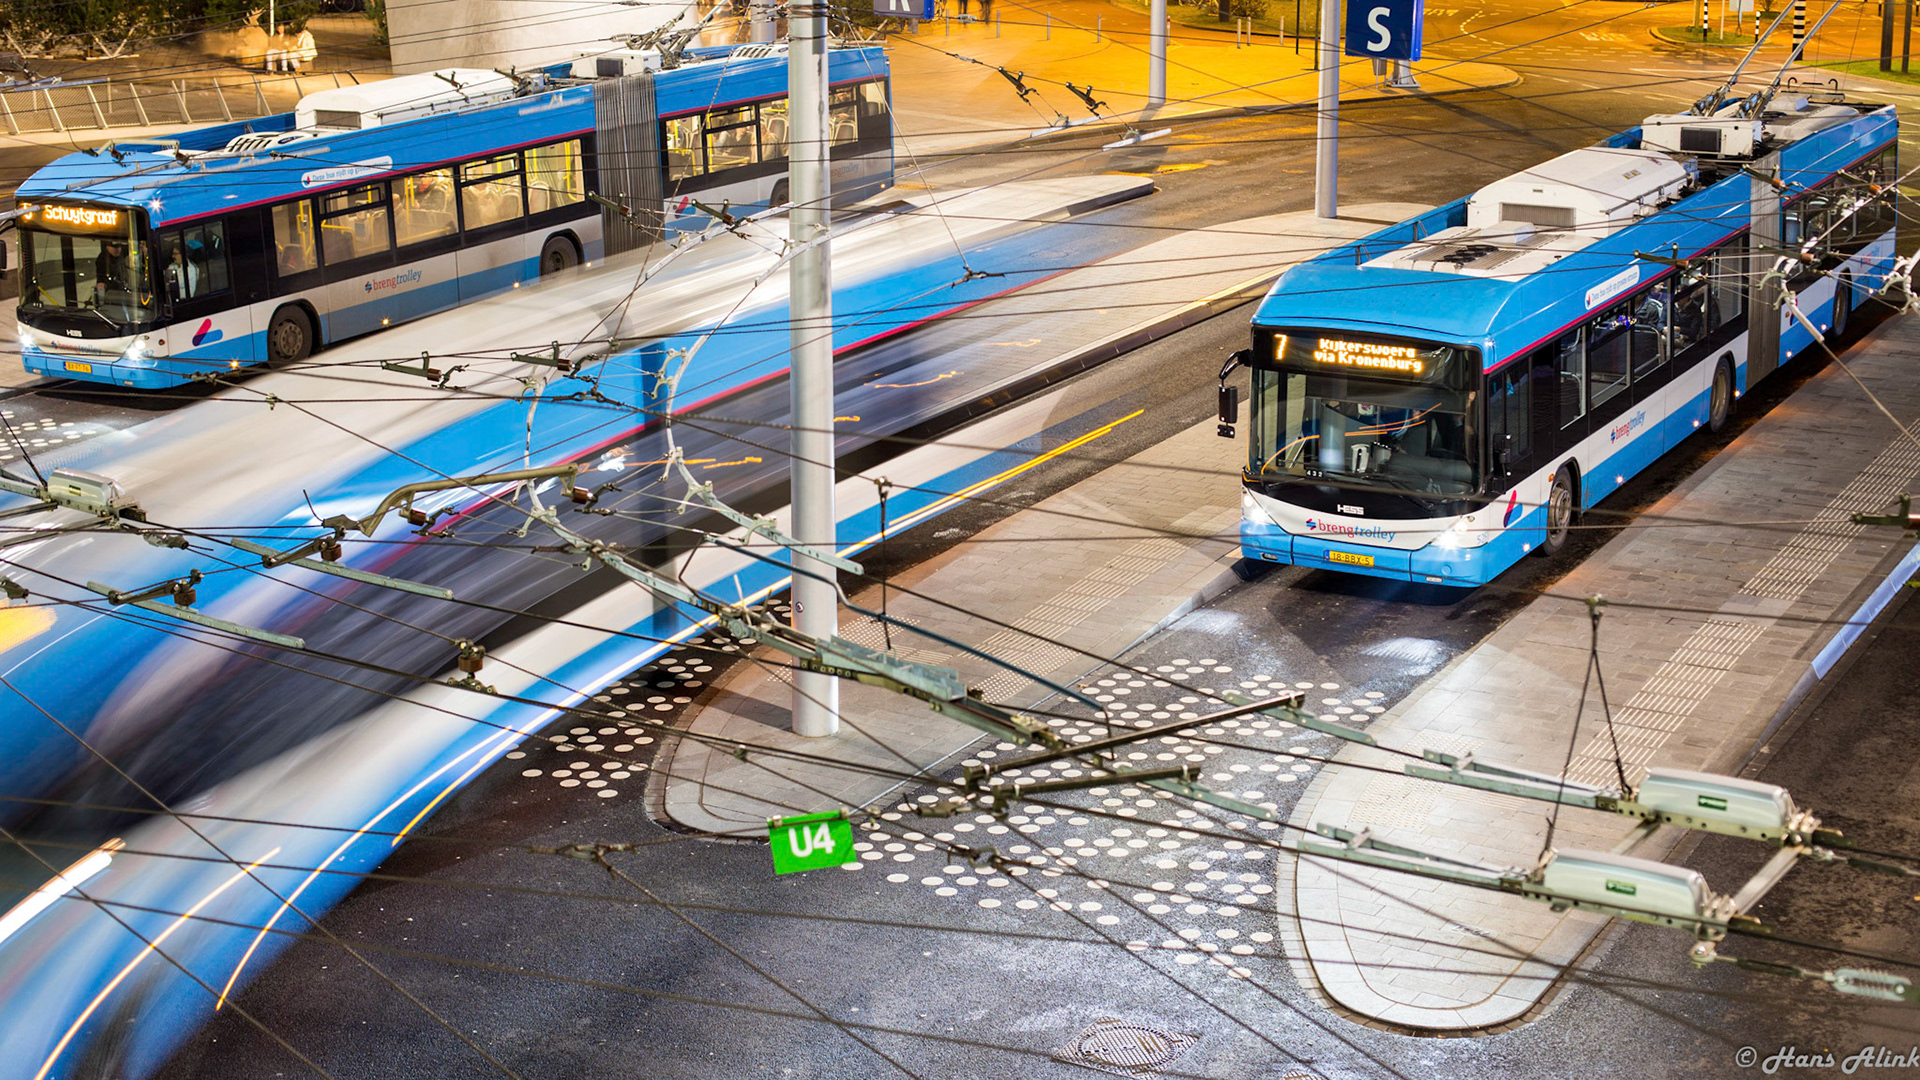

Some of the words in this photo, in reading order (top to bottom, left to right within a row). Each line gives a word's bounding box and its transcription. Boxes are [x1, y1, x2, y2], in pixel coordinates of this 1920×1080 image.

[1366, 6, 1392, 52] S
[44, 204, 118, 226] Schuytgraaf
[372, 269, 422, 290] brengtrolley
[1274, 333, 1288, 361] 7
[1313, 350, 1336, 363] via
[1337, 350, 1424, 374] Kronenburg
[1337, 504, 1364, 515] HESS
[1318, 518, 1396, 543] brengtrolley
[1332, 552, 1371, 566] 18-BBX-5
[788, 822, 836, 858] U4
